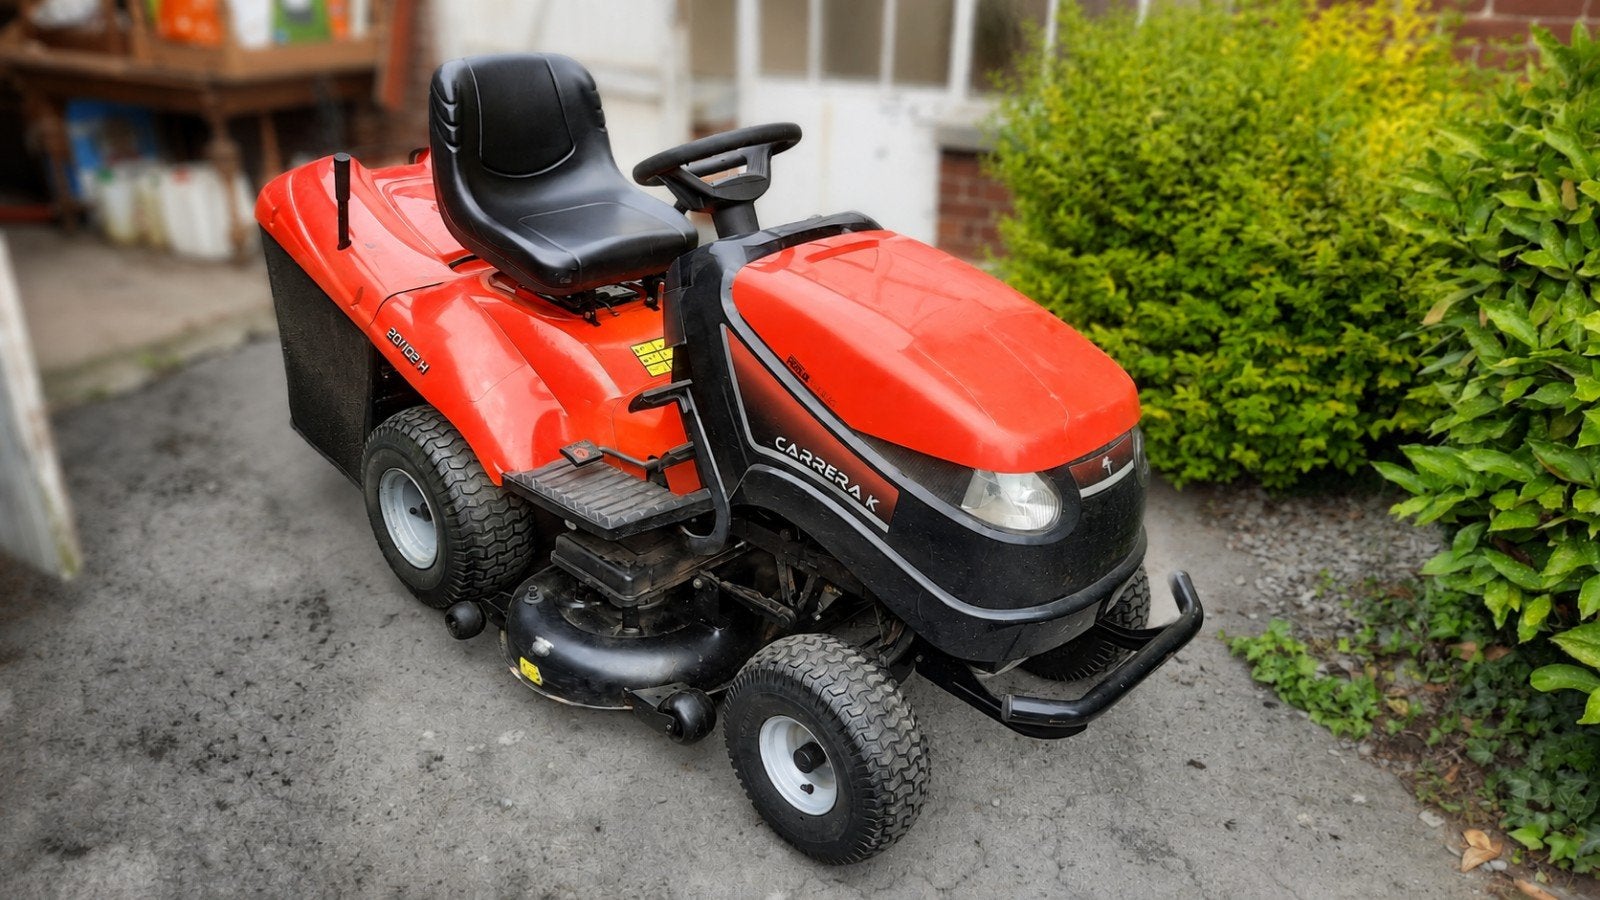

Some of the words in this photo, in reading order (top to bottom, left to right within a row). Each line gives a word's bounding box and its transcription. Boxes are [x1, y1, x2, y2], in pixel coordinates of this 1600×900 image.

[417, 360, 430, 373] H
[775, 436, 861, 500] CARRERA
[865, 494, 880, 512] K
